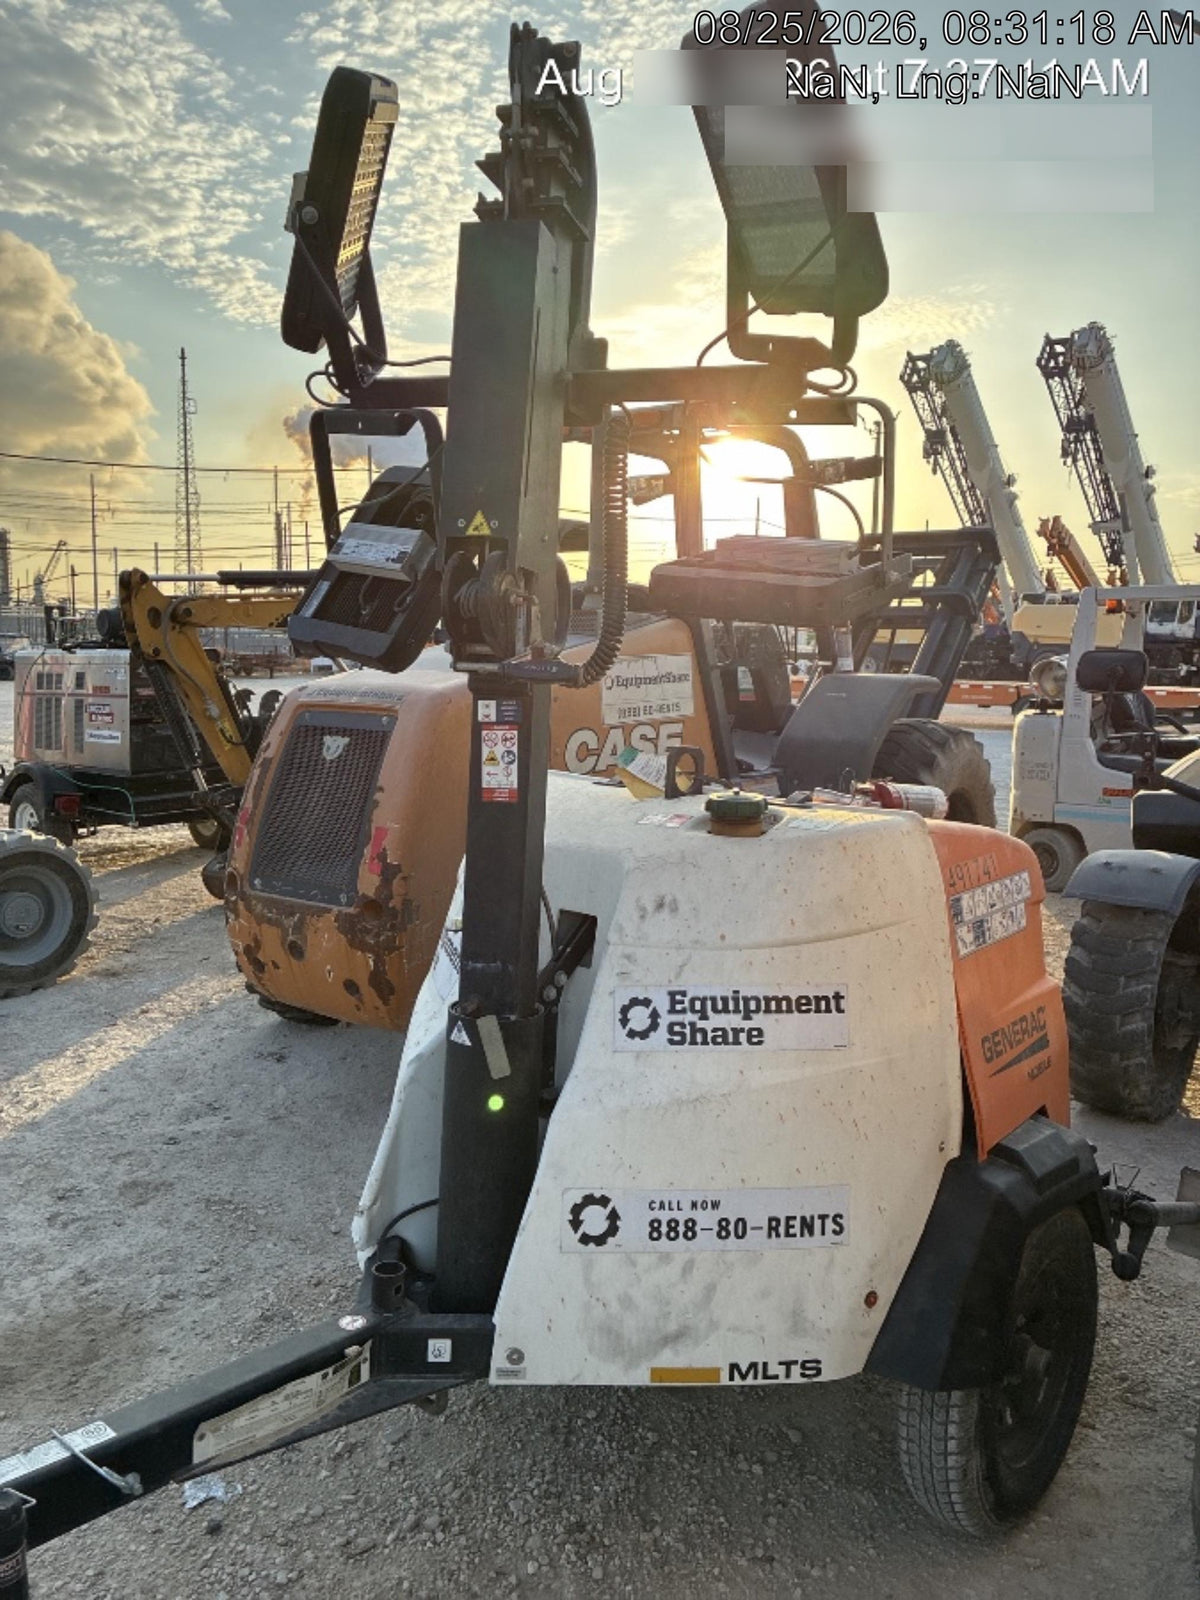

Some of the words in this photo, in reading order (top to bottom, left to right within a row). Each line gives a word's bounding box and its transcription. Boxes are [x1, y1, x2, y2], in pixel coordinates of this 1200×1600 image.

[565, 720, 684, 775] CASE
[667, 990, 845, 1021] Equipment
[667, 1021, 764, 1046] Share
[981, 1004, 1046, 1064] GENERAC
[648, 1200, 683, 1212] CALL
[690, 1200, 721, 1212] NOW
[648, 1213, 846, 1242] 888-80-RENTS
[728, 1359, 822, 1382] MLTS
